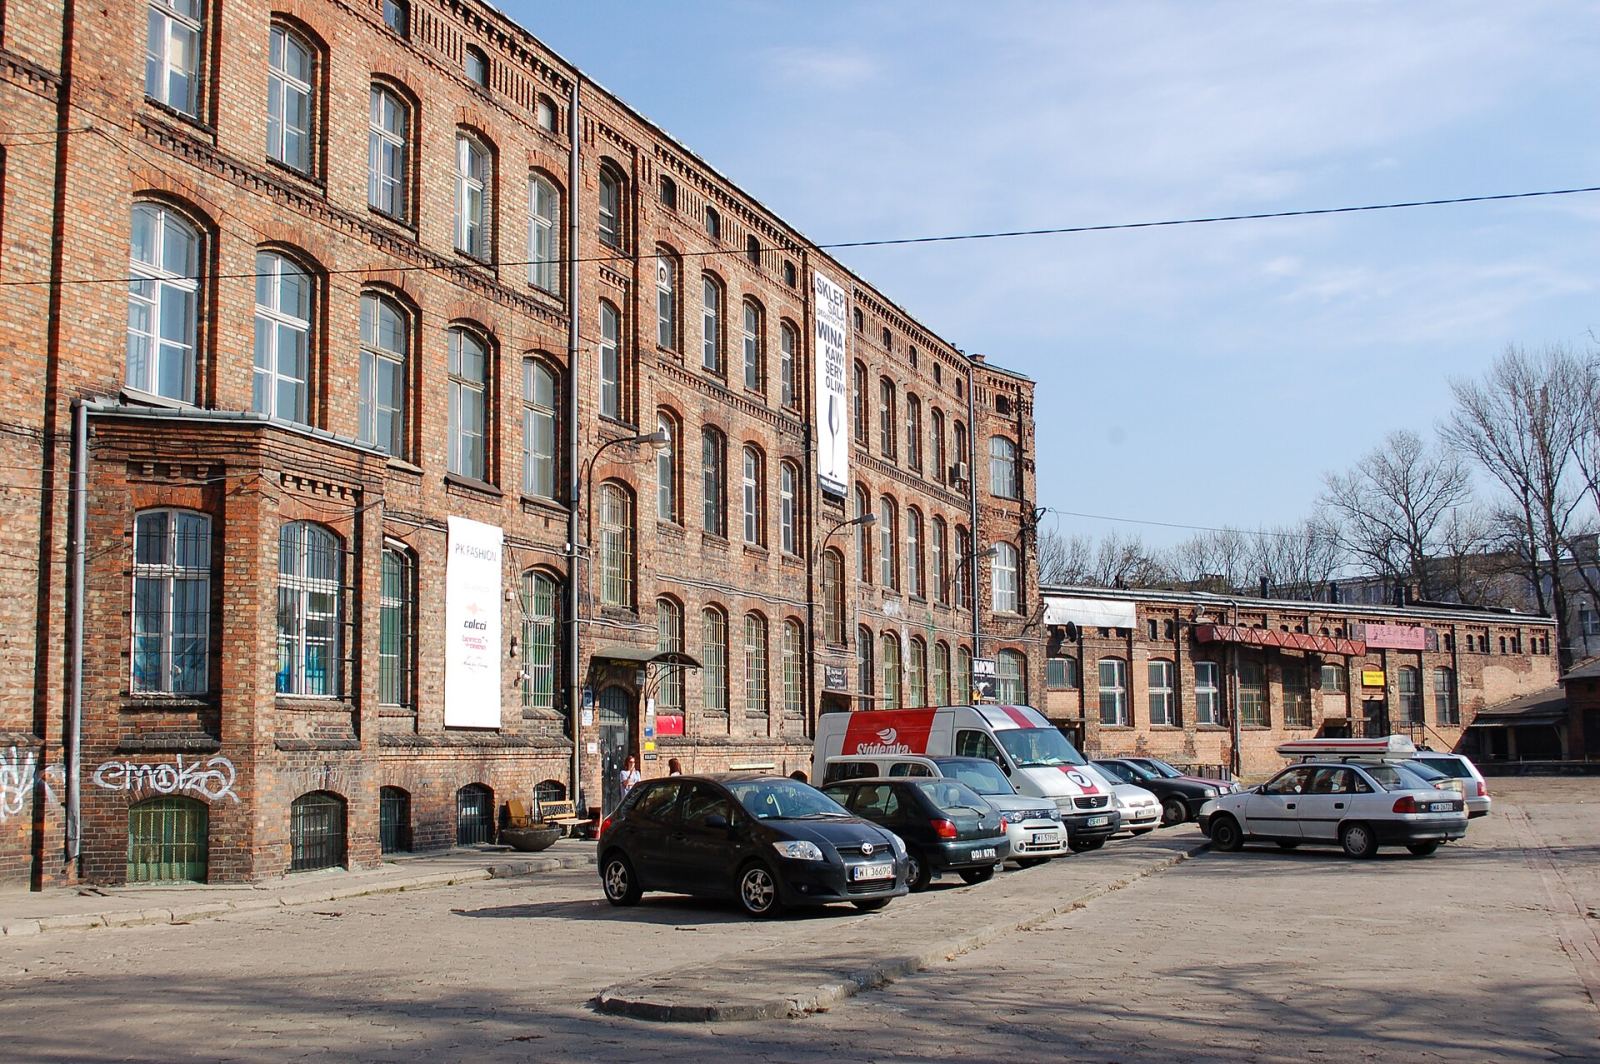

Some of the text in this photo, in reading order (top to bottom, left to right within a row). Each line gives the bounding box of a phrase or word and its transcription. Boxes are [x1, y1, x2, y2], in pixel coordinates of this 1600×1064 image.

[816, 277, 844, 308] SKLEP
[828, 301, 845, 321] SALA
[817, 319, 843, 352] WINA
[825, 360, 843, 381] SERY
[455, 543, 497, 562] PK FASHION
[463, 618, 487, 631] colcci
[1071, 774, 1085, 784] 7
[859, 865, 891, 877] WI 3669G
